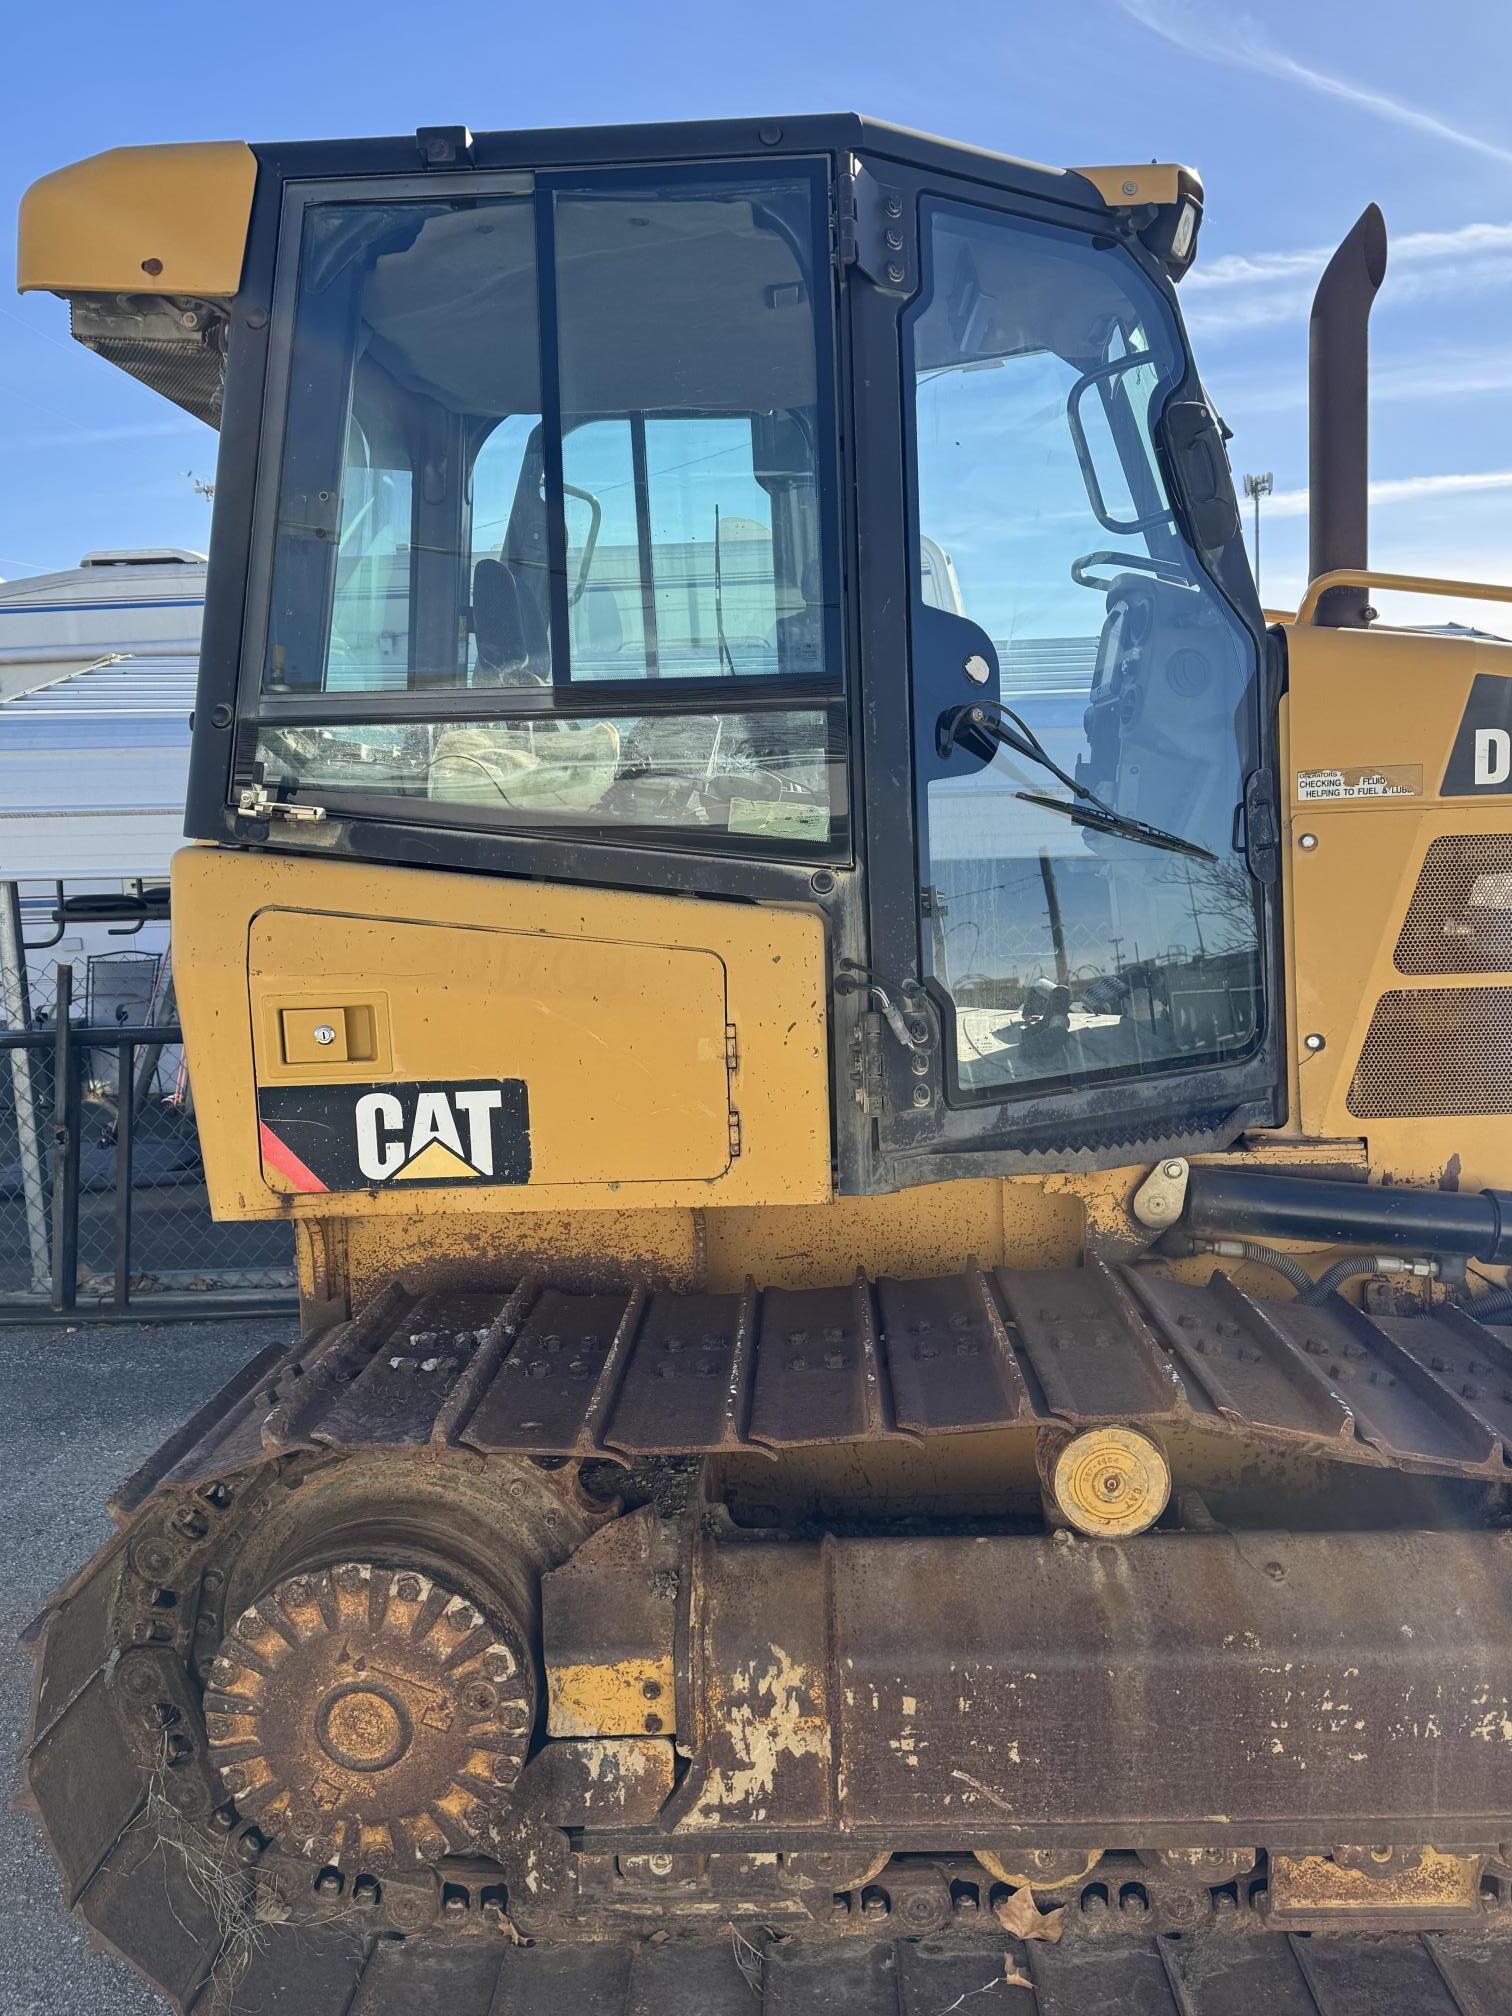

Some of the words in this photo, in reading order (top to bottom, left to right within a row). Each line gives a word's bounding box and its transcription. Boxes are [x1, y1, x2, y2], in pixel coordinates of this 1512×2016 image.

[1299, 779, 1342, 789] CHECKING
[1362, 776, 1386, 785] FLUID
[1305, 789, 1341, 798] HELPING
[1343, 788, 1355, 796] TO
[1357, 787, 1379, 795] FUEL
[1382, 786, 1388, 794] &
[355, 1090, 502, 1180] CAT
